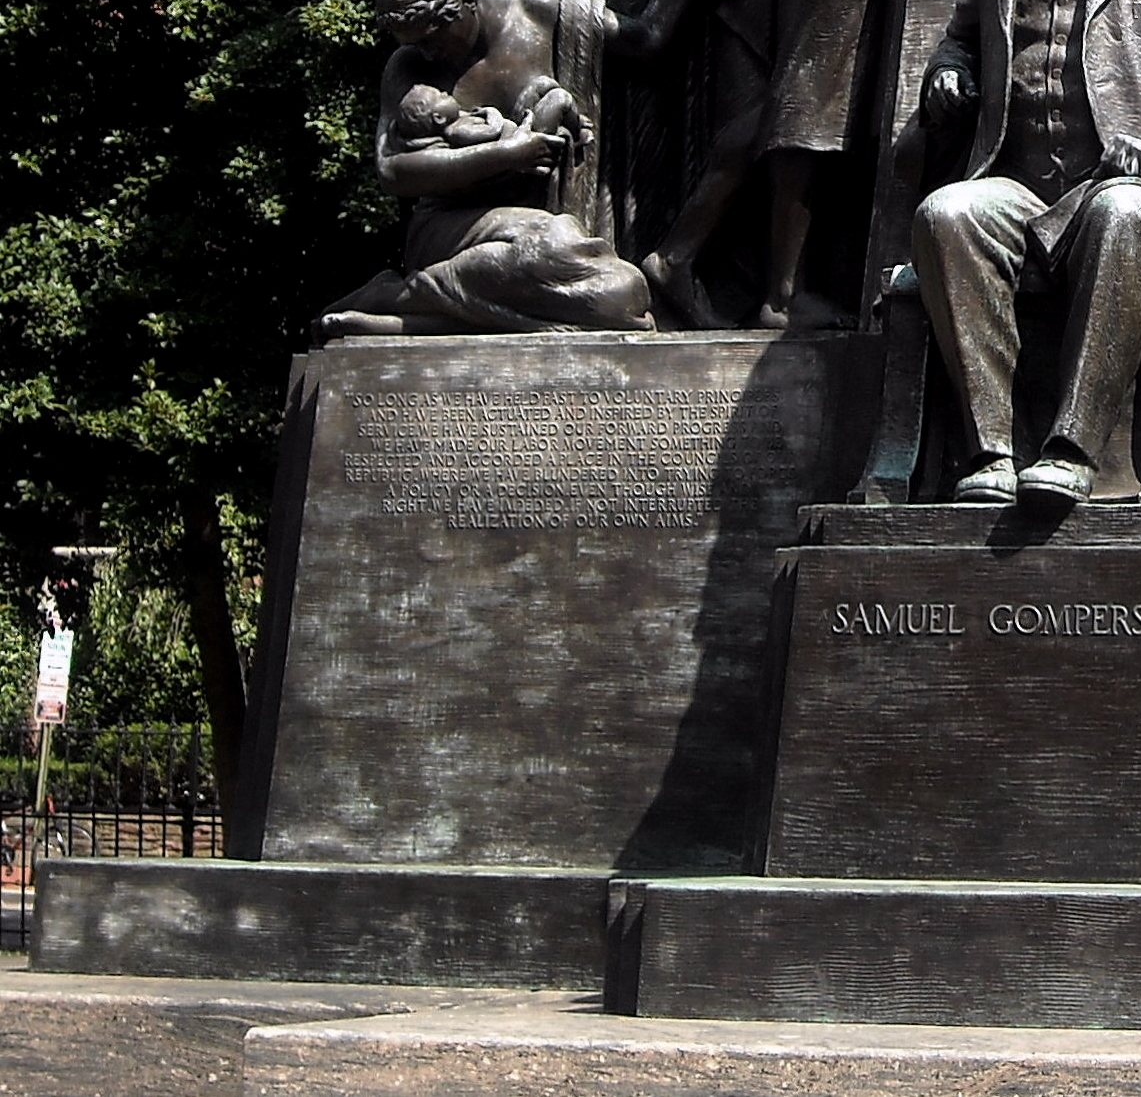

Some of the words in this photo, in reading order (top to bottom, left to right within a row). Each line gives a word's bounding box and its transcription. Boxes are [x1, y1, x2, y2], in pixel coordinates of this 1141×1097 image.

[378, 392, 418, 407] LONG
[421, 392, 438, 406] AS
[441, 392, 461, 406] WE
[465, 391, 500, 406] HAVE
[505, 391, 540, 405] HELD
[544, 391, 576, 405] FAST
[580, 391, 600, 405] TO
[603, 390, 692, 404] VOLUNTARY
[370, 409, 398, 422] AND
[402, 408, 437, 422] HAVE
[443, 408, 475, 421] BEEN
[481, 407, 550, 421] ACTUATED
[555, 407, 586, 420] AND
[590, 406, 653, 420] INSPIRED
[657, 406, 677, 419] BY
[680, 406, 707, 419] THE
[711, 405, 754, 418] SPIRIT
[419, 423, 438, 436] WE
[443, 423, 478, 436] HAVE
[482, 422, 559, 435] SUSTAINED
[564, 422, 593, 435] OUR
[598, 421, 668, 434] FORWARD
[372, 438, 391, 452] WE
[395, 438, 430, 452] HAVE
[433, 438, 474, 452] MADE
[478, 438, 508, 451] OUR
[512, 437, 558, 451] LABOR
[564, 437, 645, 451] MOVEMENT
[344, 453, 422, 467] RESPECTED
[428, 453, 456, 466] AND
[463, 452, 543, 466] ACCORDED
[546, 452, 556, 466] A
[560, 452, 602, 466] PLACE
[608, 452, 622, 465] IN
[628, 452, 655, 465] THE
[420, 468, 466, 482] WHERE
[470, 468, 490, 481] WE
[493, 468, 529, 481] HAVE
[535, 468, 618, 481] BLUNDERED
[623, 467, 659, 481] INTO
[386, 483, 396, 497] A
[401, 483, 452, 497] POLICY
[459, 483, 481, 497] OR
[487, 483, 494, 497] A
[570, 483, 607, 496] EVEN
[612, 483, 676, 496] THOUGH
[681, 483, 714, 496] WISE
[432, 499, 451, 513] WE
[457, 499, 494, 512] HAVE
[570, 499, 582, 512] IF
[586, 499, 617, 512] NOT
[448, 514, 545, 528] REALIZATION
[550, 514, 569, 528] OF
[576, 514, 608, 528] OUR
[614, 513, 649, 528] OWN
[832, 603, 965, 635] SAMUEL
